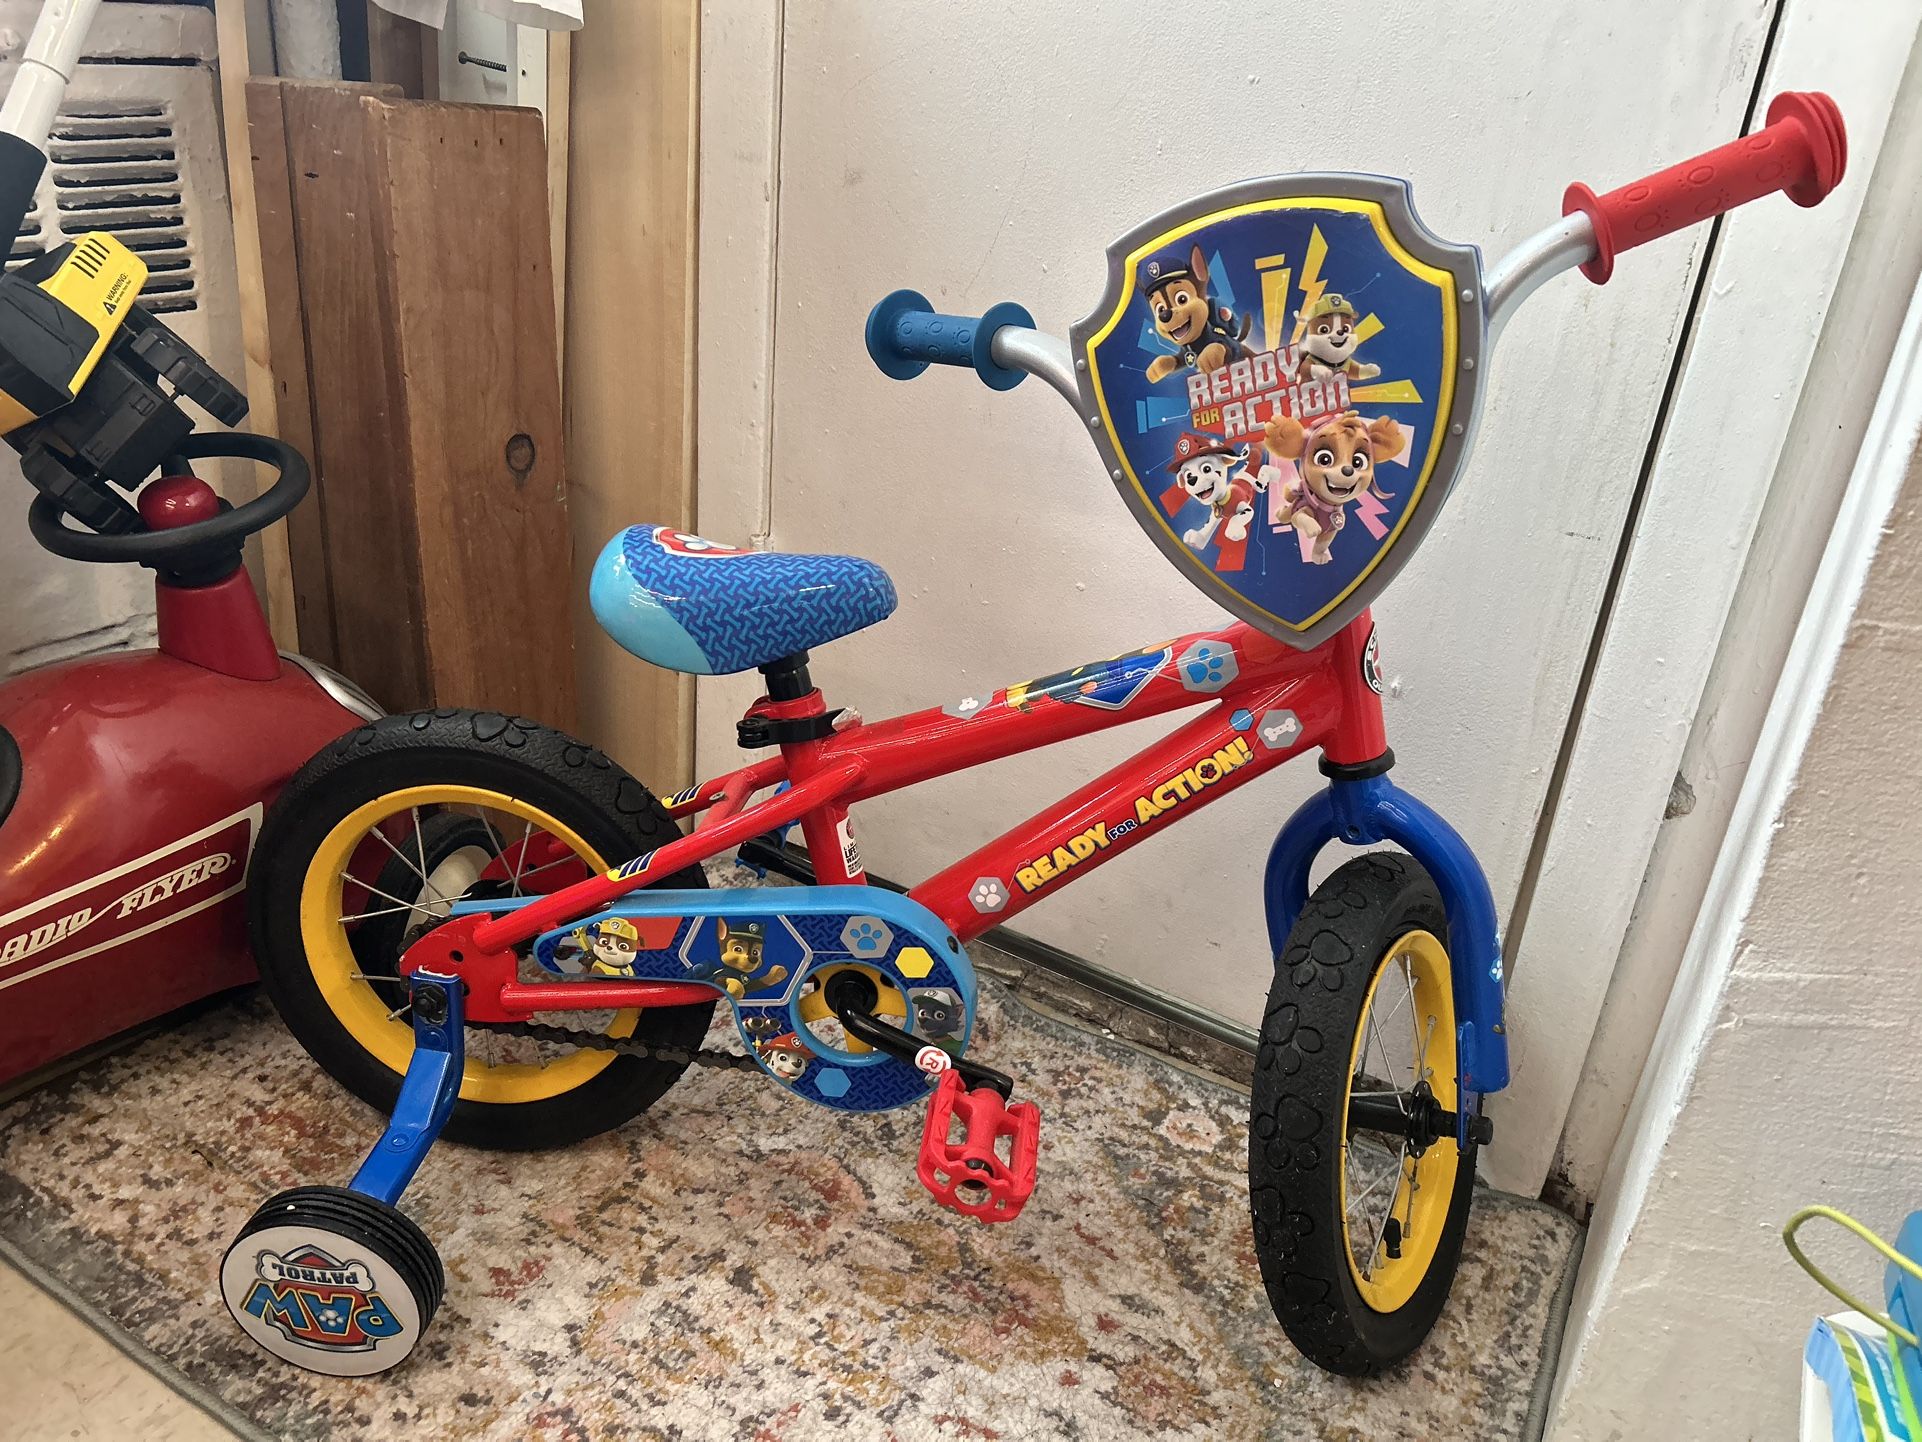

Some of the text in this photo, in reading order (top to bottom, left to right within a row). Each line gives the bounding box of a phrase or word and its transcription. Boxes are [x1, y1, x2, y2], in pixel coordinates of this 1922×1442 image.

[106, 272, 128, 301] WARNING:
[1187, 343, 1300, 411] READY
[1192, 371, 1351, 440] FOR ACTION
[1015, 736, 1254, 893] READY FOR ACTION!
[0, 853, 232, 964] ADIO FLYER
[271, 1262, 360, 1286] PATROL
[242, 1281, 404, 1338] PAW
